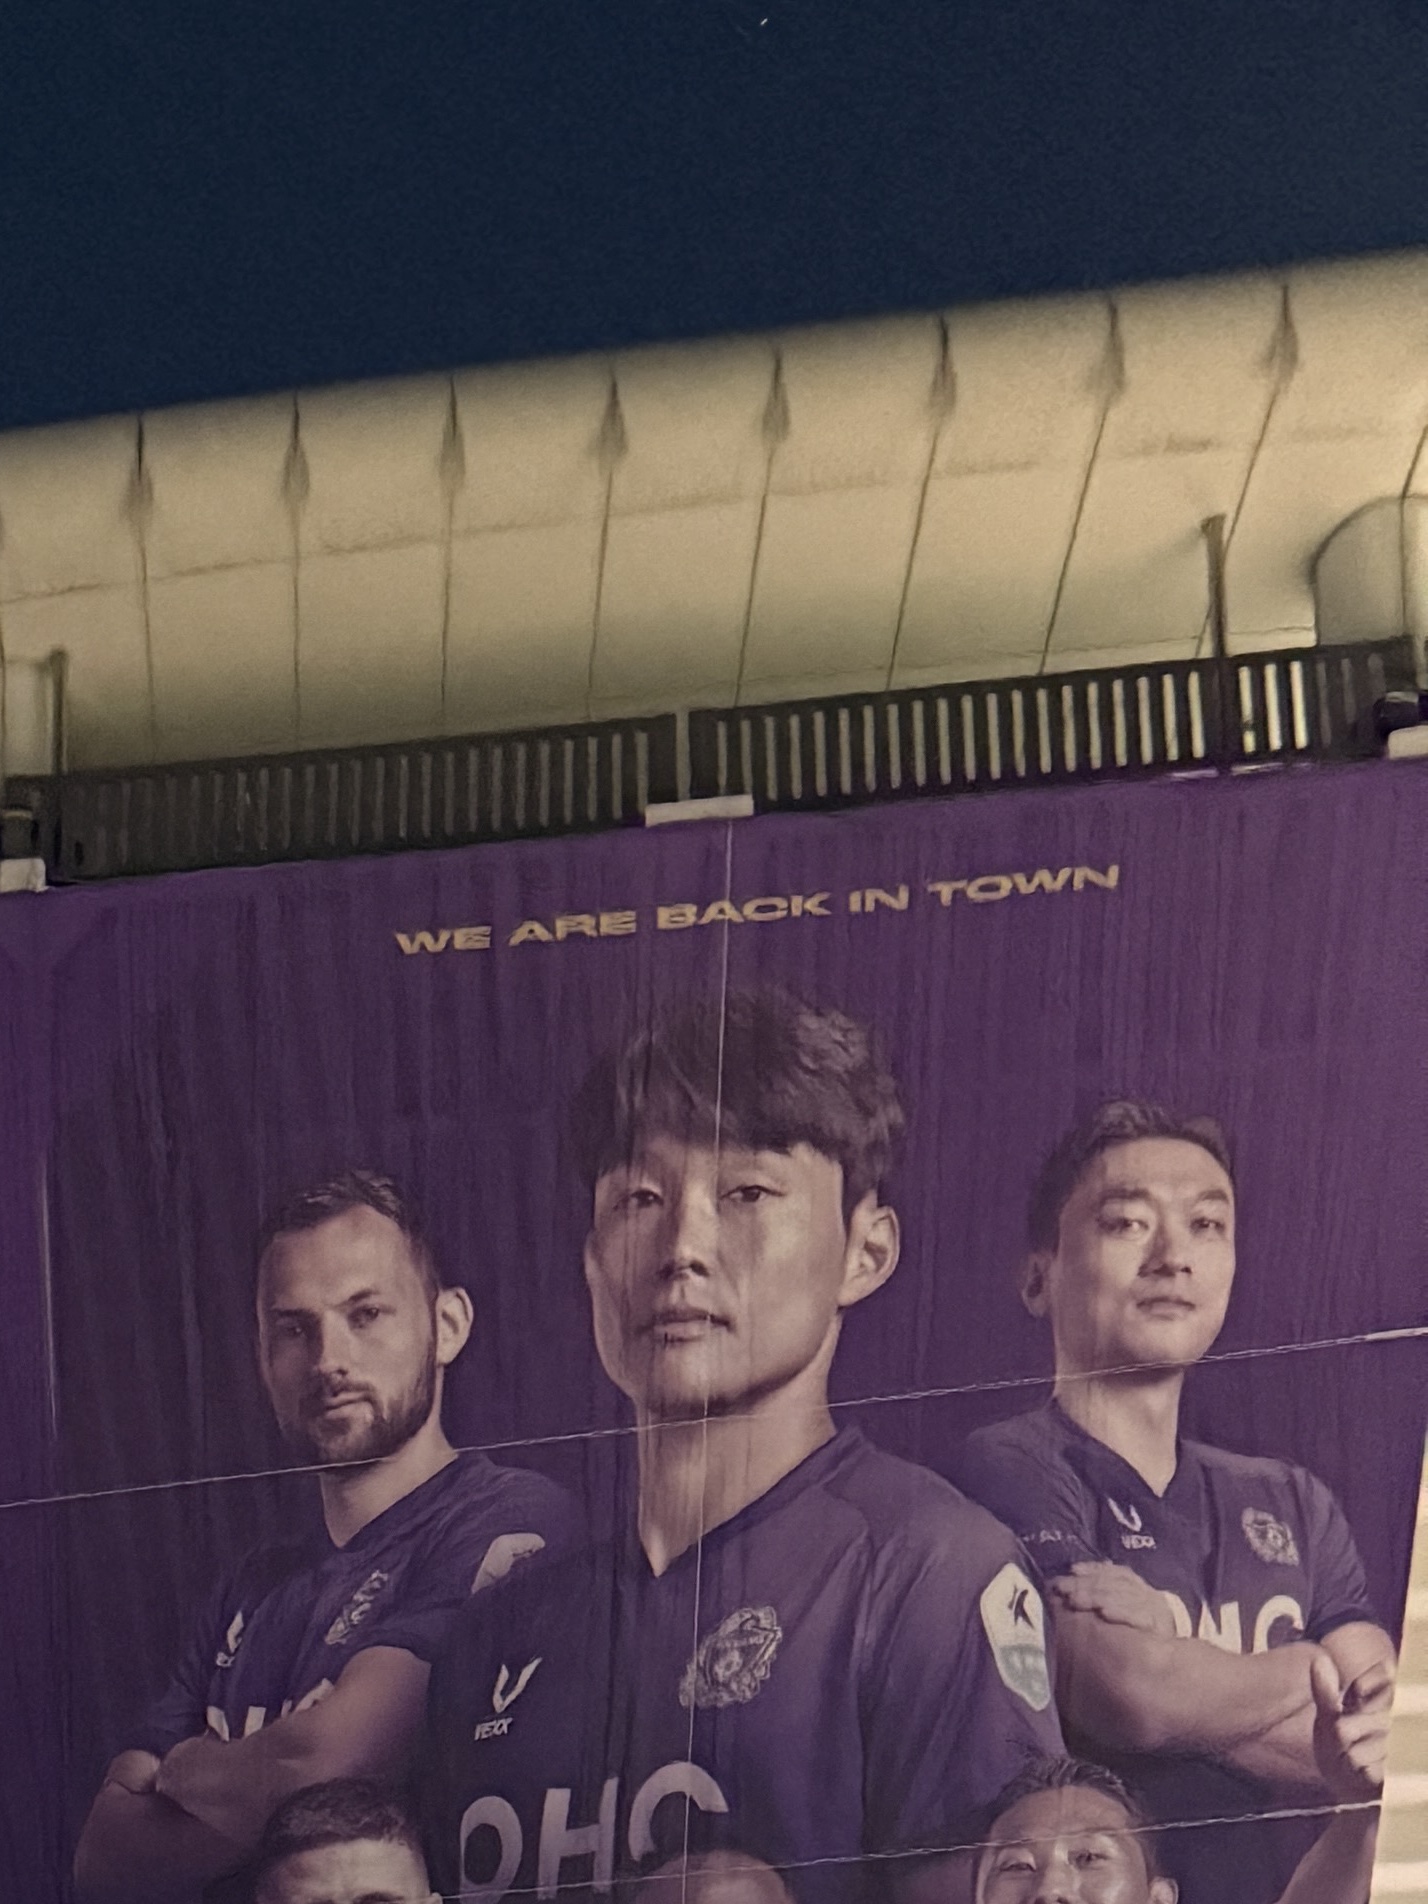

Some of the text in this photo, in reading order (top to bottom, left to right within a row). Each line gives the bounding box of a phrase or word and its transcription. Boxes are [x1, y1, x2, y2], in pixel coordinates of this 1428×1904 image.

[395, 864, 1121, 956] WE ARE BACK IN TOWN
